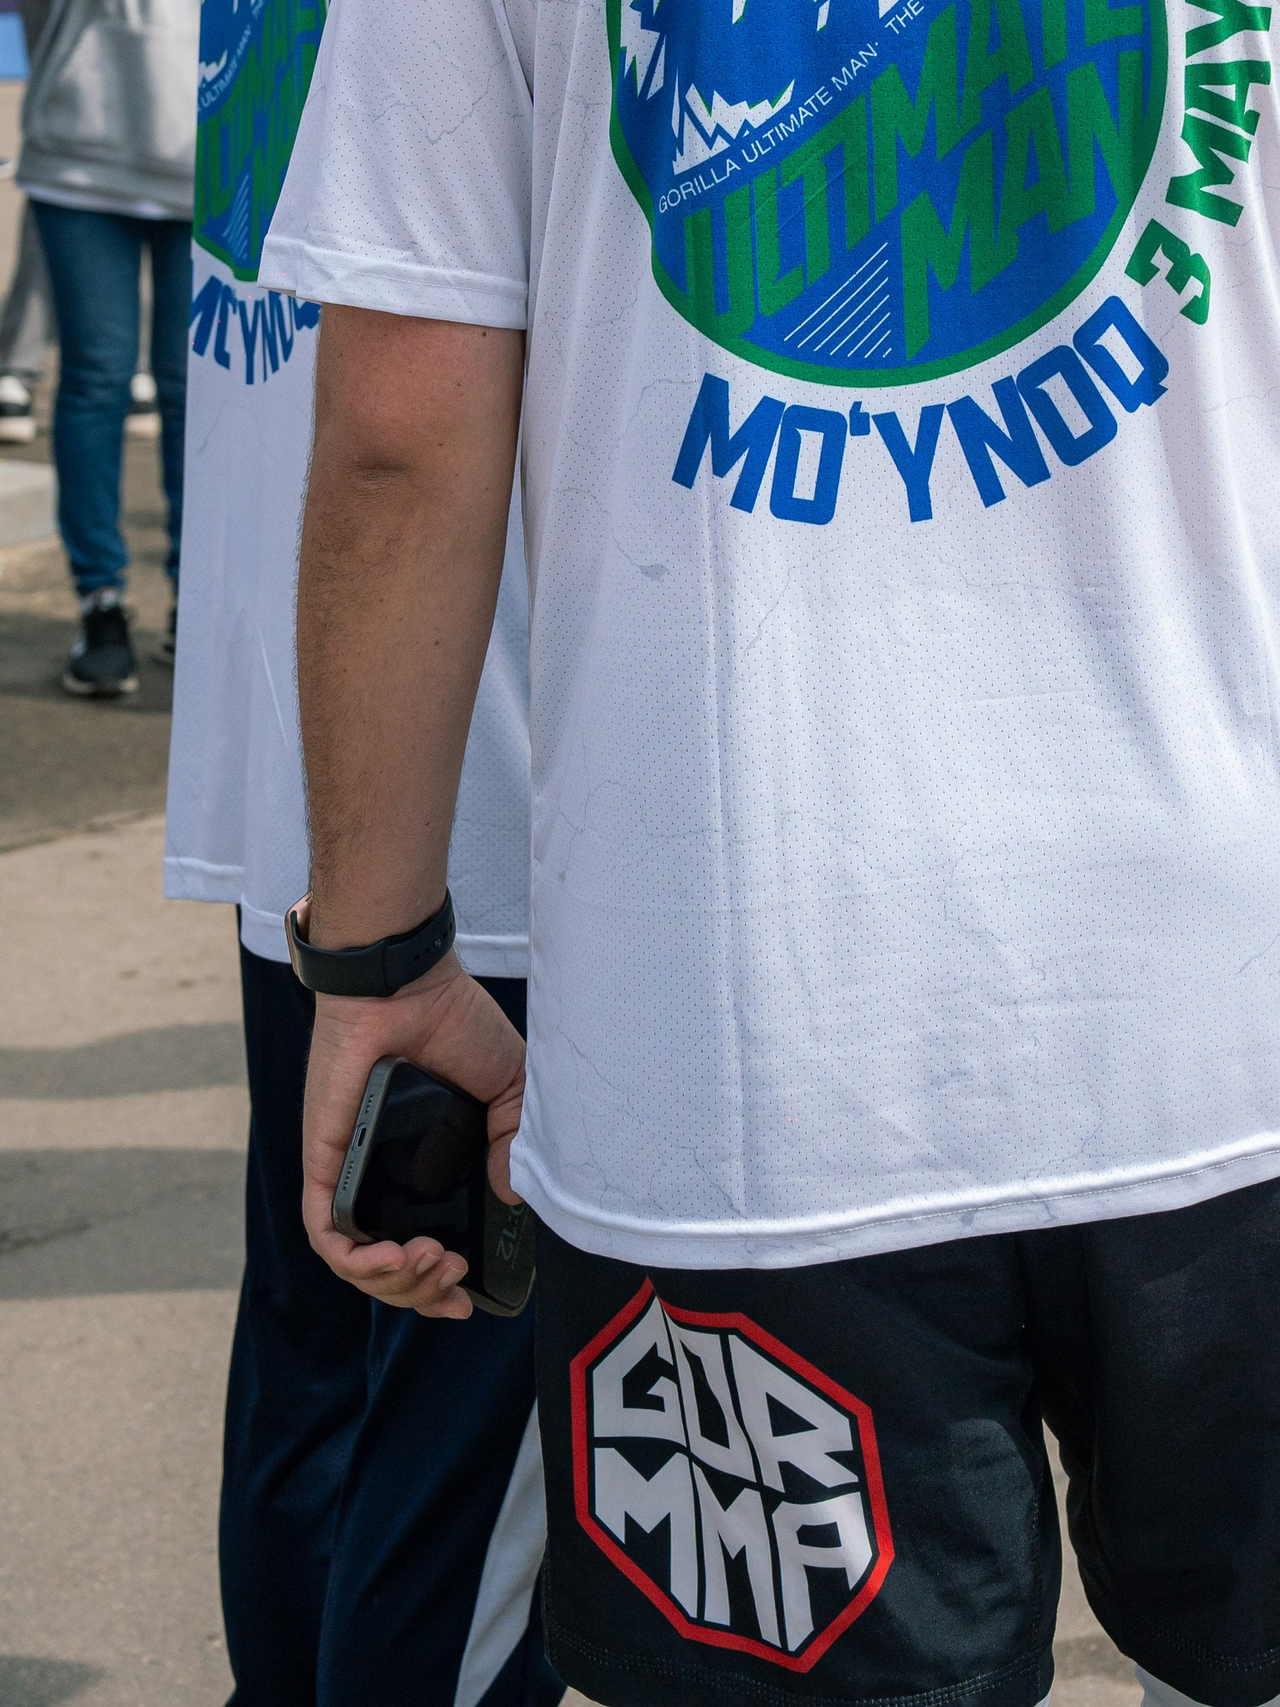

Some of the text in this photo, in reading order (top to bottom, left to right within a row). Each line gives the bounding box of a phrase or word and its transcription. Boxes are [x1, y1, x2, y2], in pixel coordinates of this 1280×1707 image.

[658, 157, 741, 214] GORILLA
[741, 86, 833, 164] ULTIMATE
[901, 52, 1151, 362] MAN
[1126, 229, 1211, 326] 3
[593, 1441, 873, 1653] MMA
